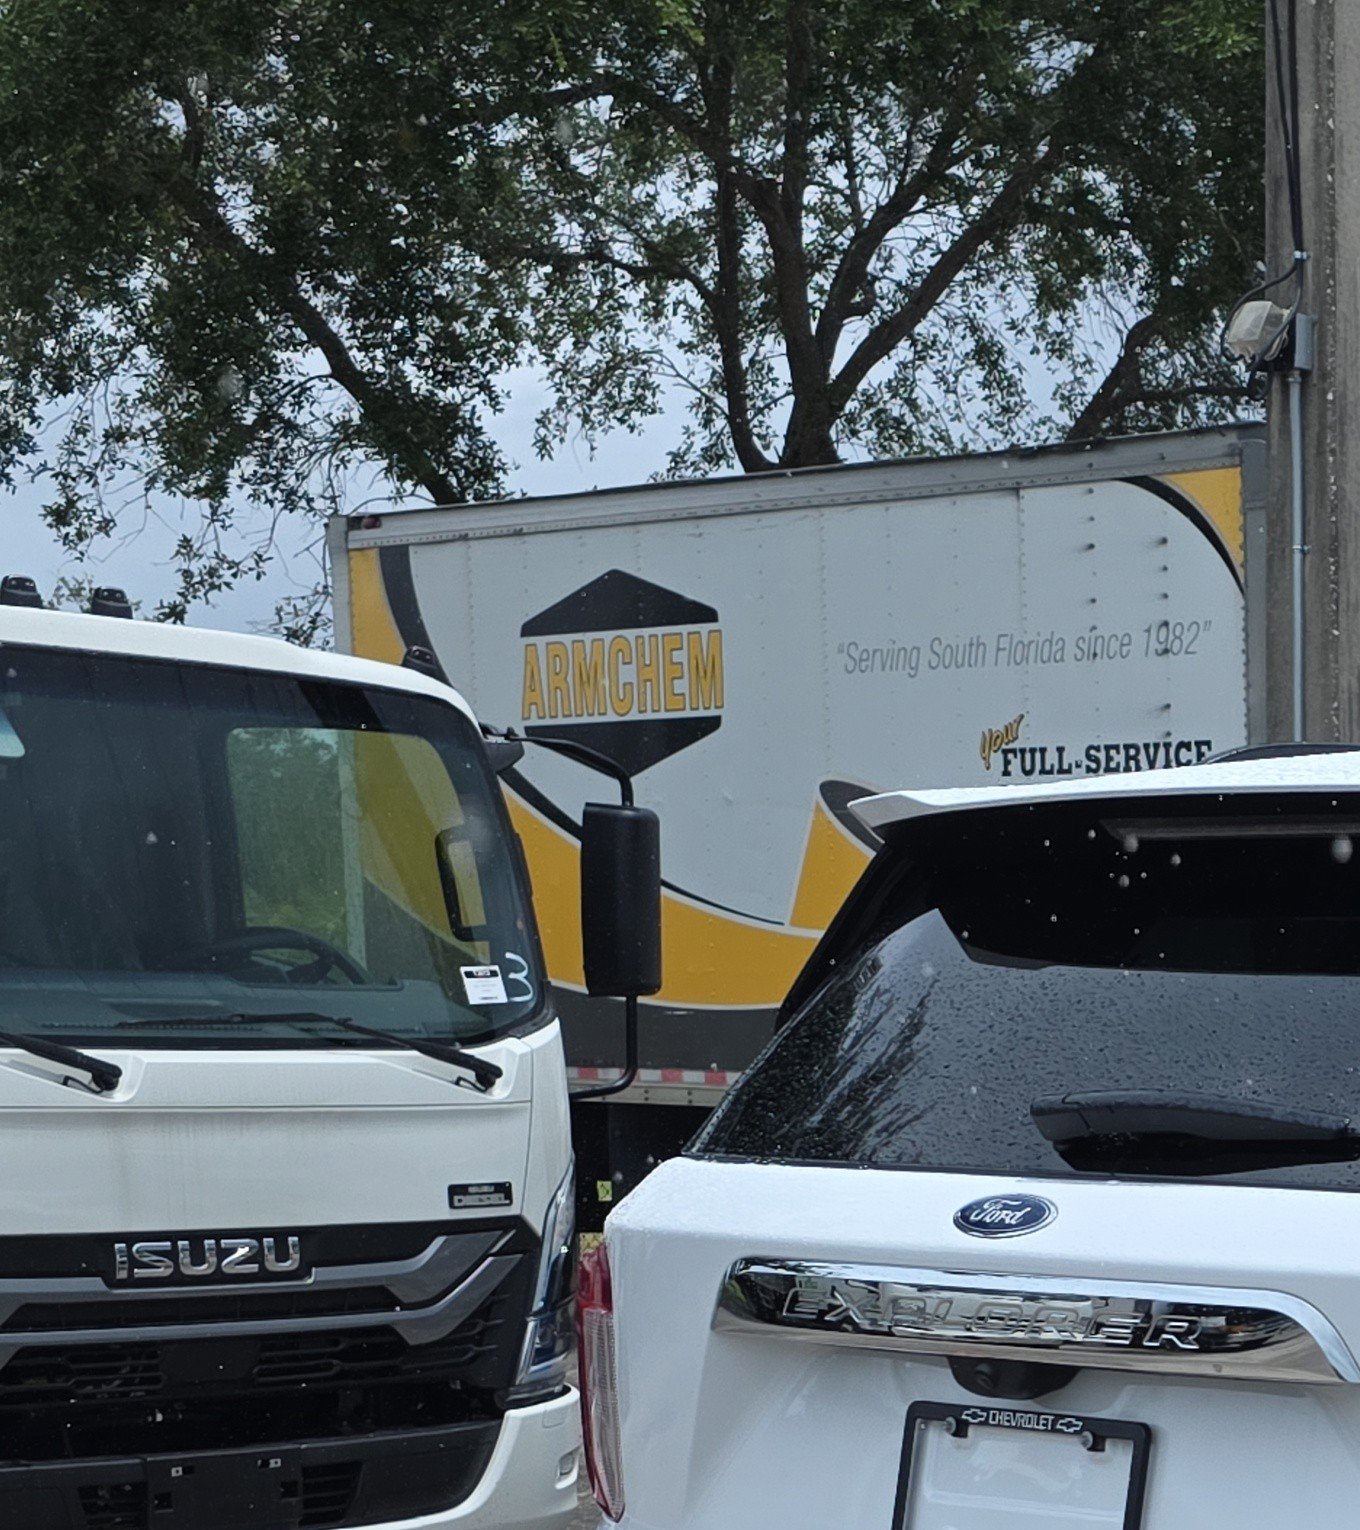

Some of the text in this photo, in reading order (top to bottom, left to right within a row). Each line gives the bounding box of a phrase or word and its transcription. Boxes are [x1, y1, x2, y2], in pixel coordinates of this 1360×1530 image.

[927, 633, 987, 671] South
[993, 628, 1066, 667] Florida
[1073, 625, 1133, 662] since
[521, 629, 724, 720] ARMCHEM
[1002, 740, 1213, 777] FULL-SERVICE
[969, 1198, 1032, 1225] Ford
[114, 1236, 300, 1280] ISUZU
[781, 1286, 1202, 1350] EXPLORER
[987, 1411, 1055, 1432] CHEVROLET
